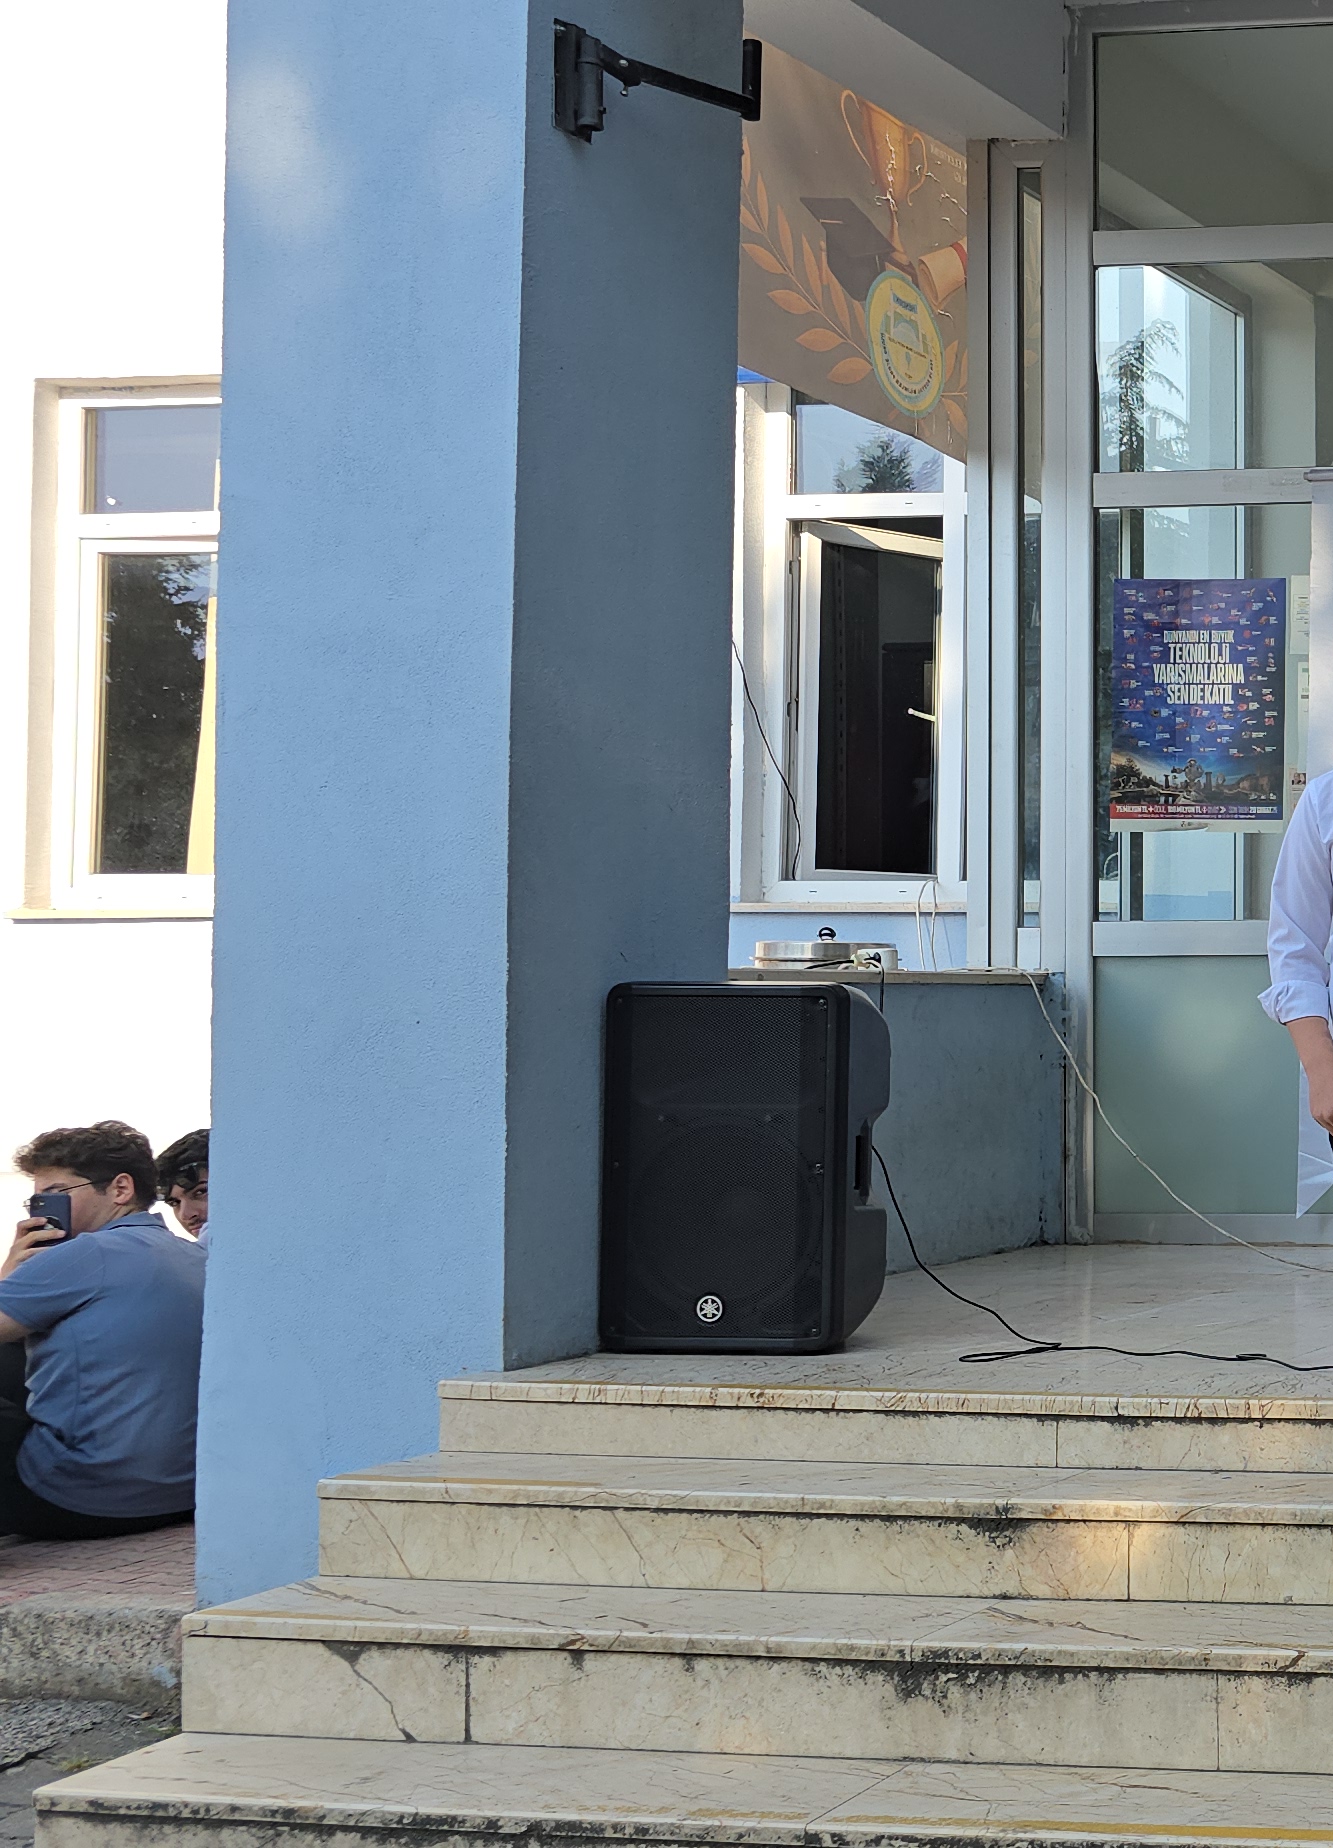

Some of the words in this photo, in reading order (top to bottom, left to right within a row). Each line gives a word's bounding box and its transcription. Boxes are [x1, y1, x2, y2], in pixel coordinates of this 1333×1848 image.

[1200, 630, 1209, 643] EN
[1167, 684, 1189, 705] SEN
[1189, 684, 1204, 704] DE
[1204, 684, 1234, 704] KATIL
